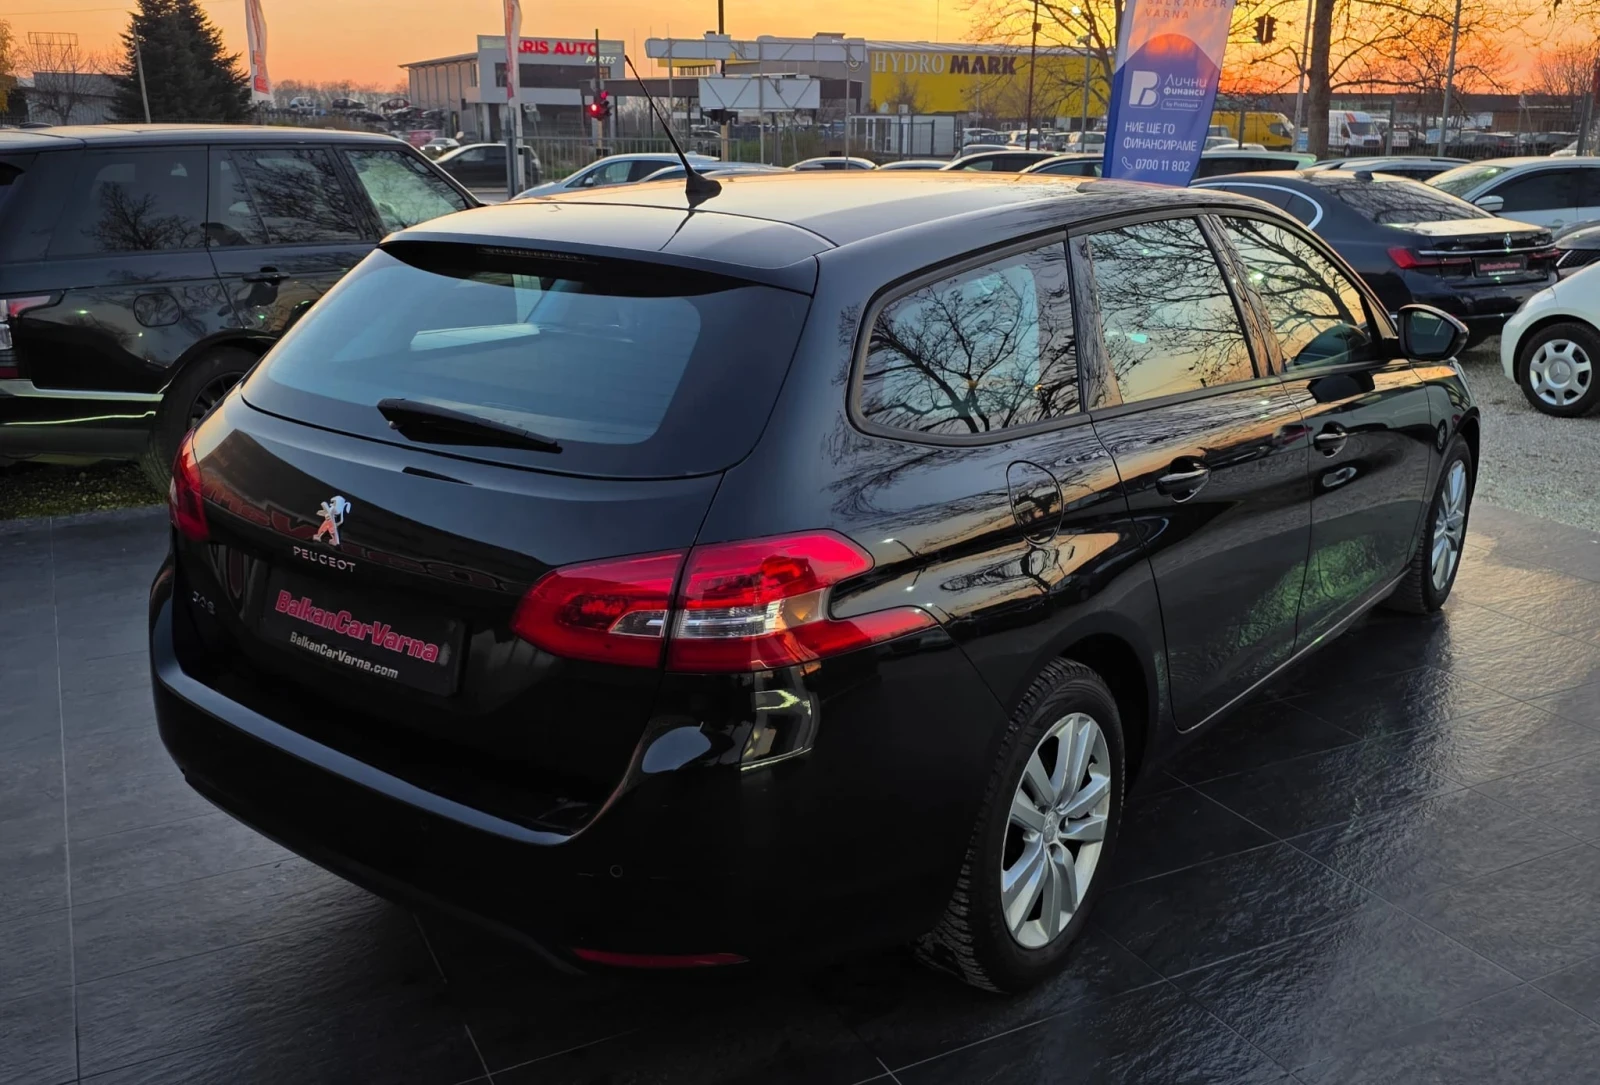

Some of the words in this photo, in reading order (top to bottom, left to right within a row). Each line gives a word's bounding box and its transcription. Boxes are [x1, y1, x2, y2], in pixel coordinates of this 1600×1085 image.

[1145, 9, 1189, 19] VARNA
[874, 52, 945, 74] HYDRO
[949, 55, 1017, 75] MARK
[1164, 73, 1207, 88] Лични
[1125, 121, 1145, 133] НИЕ
[1146, 122, 1162, 135] ЩЕ
[1163, 123, 1176, 135] ГО
[1123, 136, 1198, 152] ФИНАНСИРАМЕ
[1135, 158, 1159, 171] 0700
[1161, 160, 1169, 171] 11
[1171, 160, 1191, 172] 802
[293, 546, 356, 573] PEUGEOT
[275, 589, 439, 663] BalkanCarVarna
[290, 631, 399, 679] BalkanCarVarna.com
